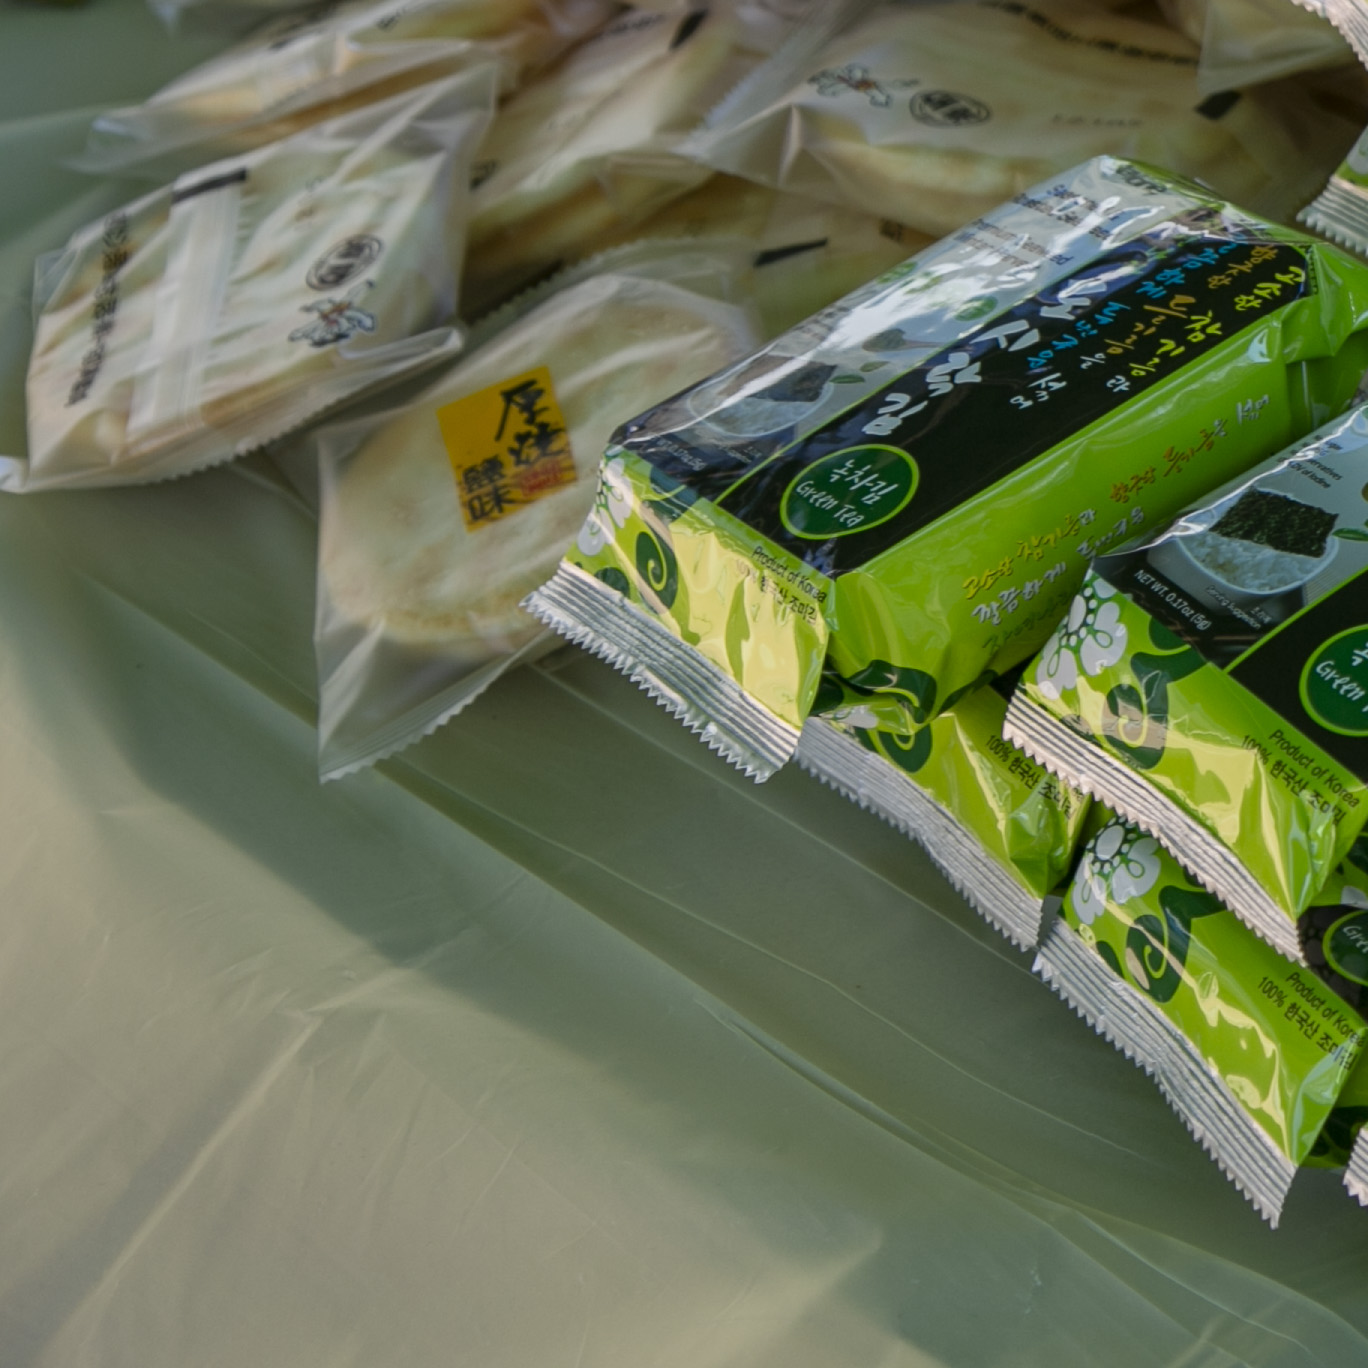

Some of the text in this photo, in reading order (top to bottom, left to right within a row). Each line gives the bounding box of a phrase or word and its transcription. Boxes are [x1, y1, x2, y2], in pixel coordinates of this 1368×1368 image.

[789, 477, 872, 528] Green Tea
[819, 455, 901, 507] 녹차김
[1131, 569, 1213, 632] NET WT. 0.17oz (5g)
[1236, 733, 1276, 765] 100%
[1265, 760, 1315, 799] 한국산
[1265, 729, 1364, 808] Product of Korea
[1284, 968, 1367, 1052] Product of Korea
